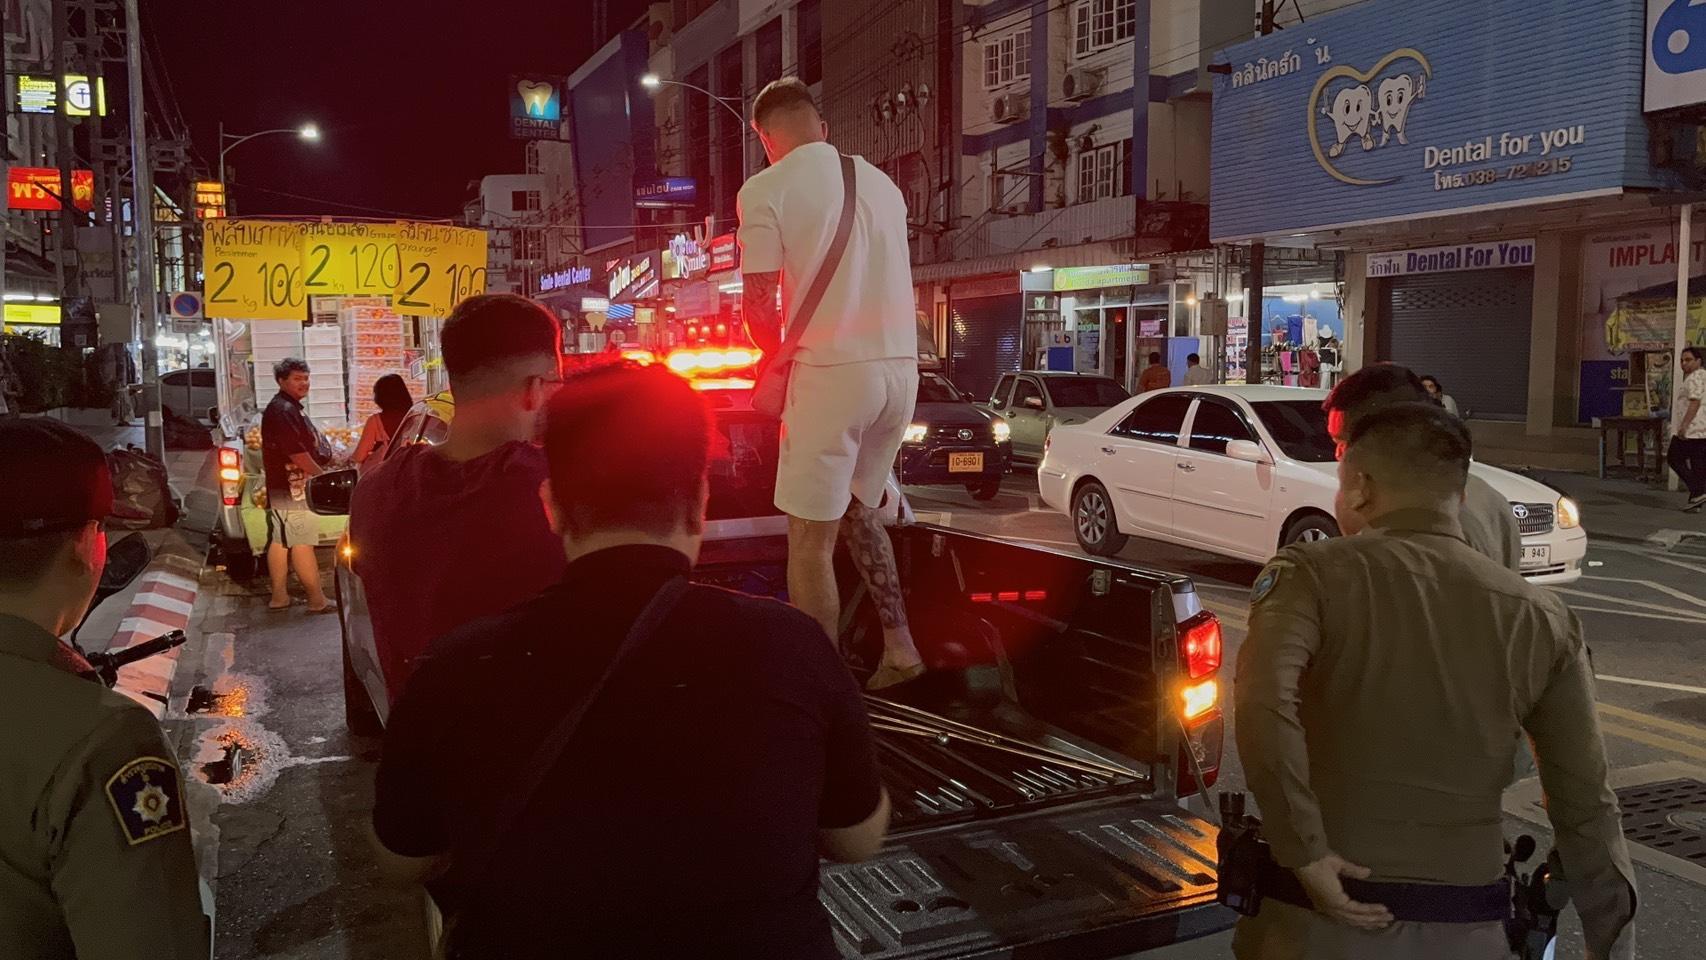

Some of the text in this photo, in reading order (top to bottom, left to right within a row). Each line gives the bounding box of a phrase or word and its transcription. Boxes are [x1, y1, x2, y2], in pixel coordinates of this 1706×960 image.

[514, 117, 557, 129] DENTAL
[514, 128, 557, 139] CENTER
[1424, 125, 1585, 169] Dental for you
[305, 244, 330, 286] 2
[350, 242, 402, 289] 120
[683, 253, 706, 279] Smile
[1406, 243, 1533, 272] Dental For You
[1609, 240, 1704, 267] IMPLAT
[210, 261, 305, 312] 2 kg 100
[397, 262, 487, 316] 2 kg 100
[540, 273, 554, 291] Smile
[554, 268, 571, 288] Dental
[572, 265, 591, 284] Center
[1098, 273, 1140, 287] apartment
[1531, 548, 1546, 558] 943
